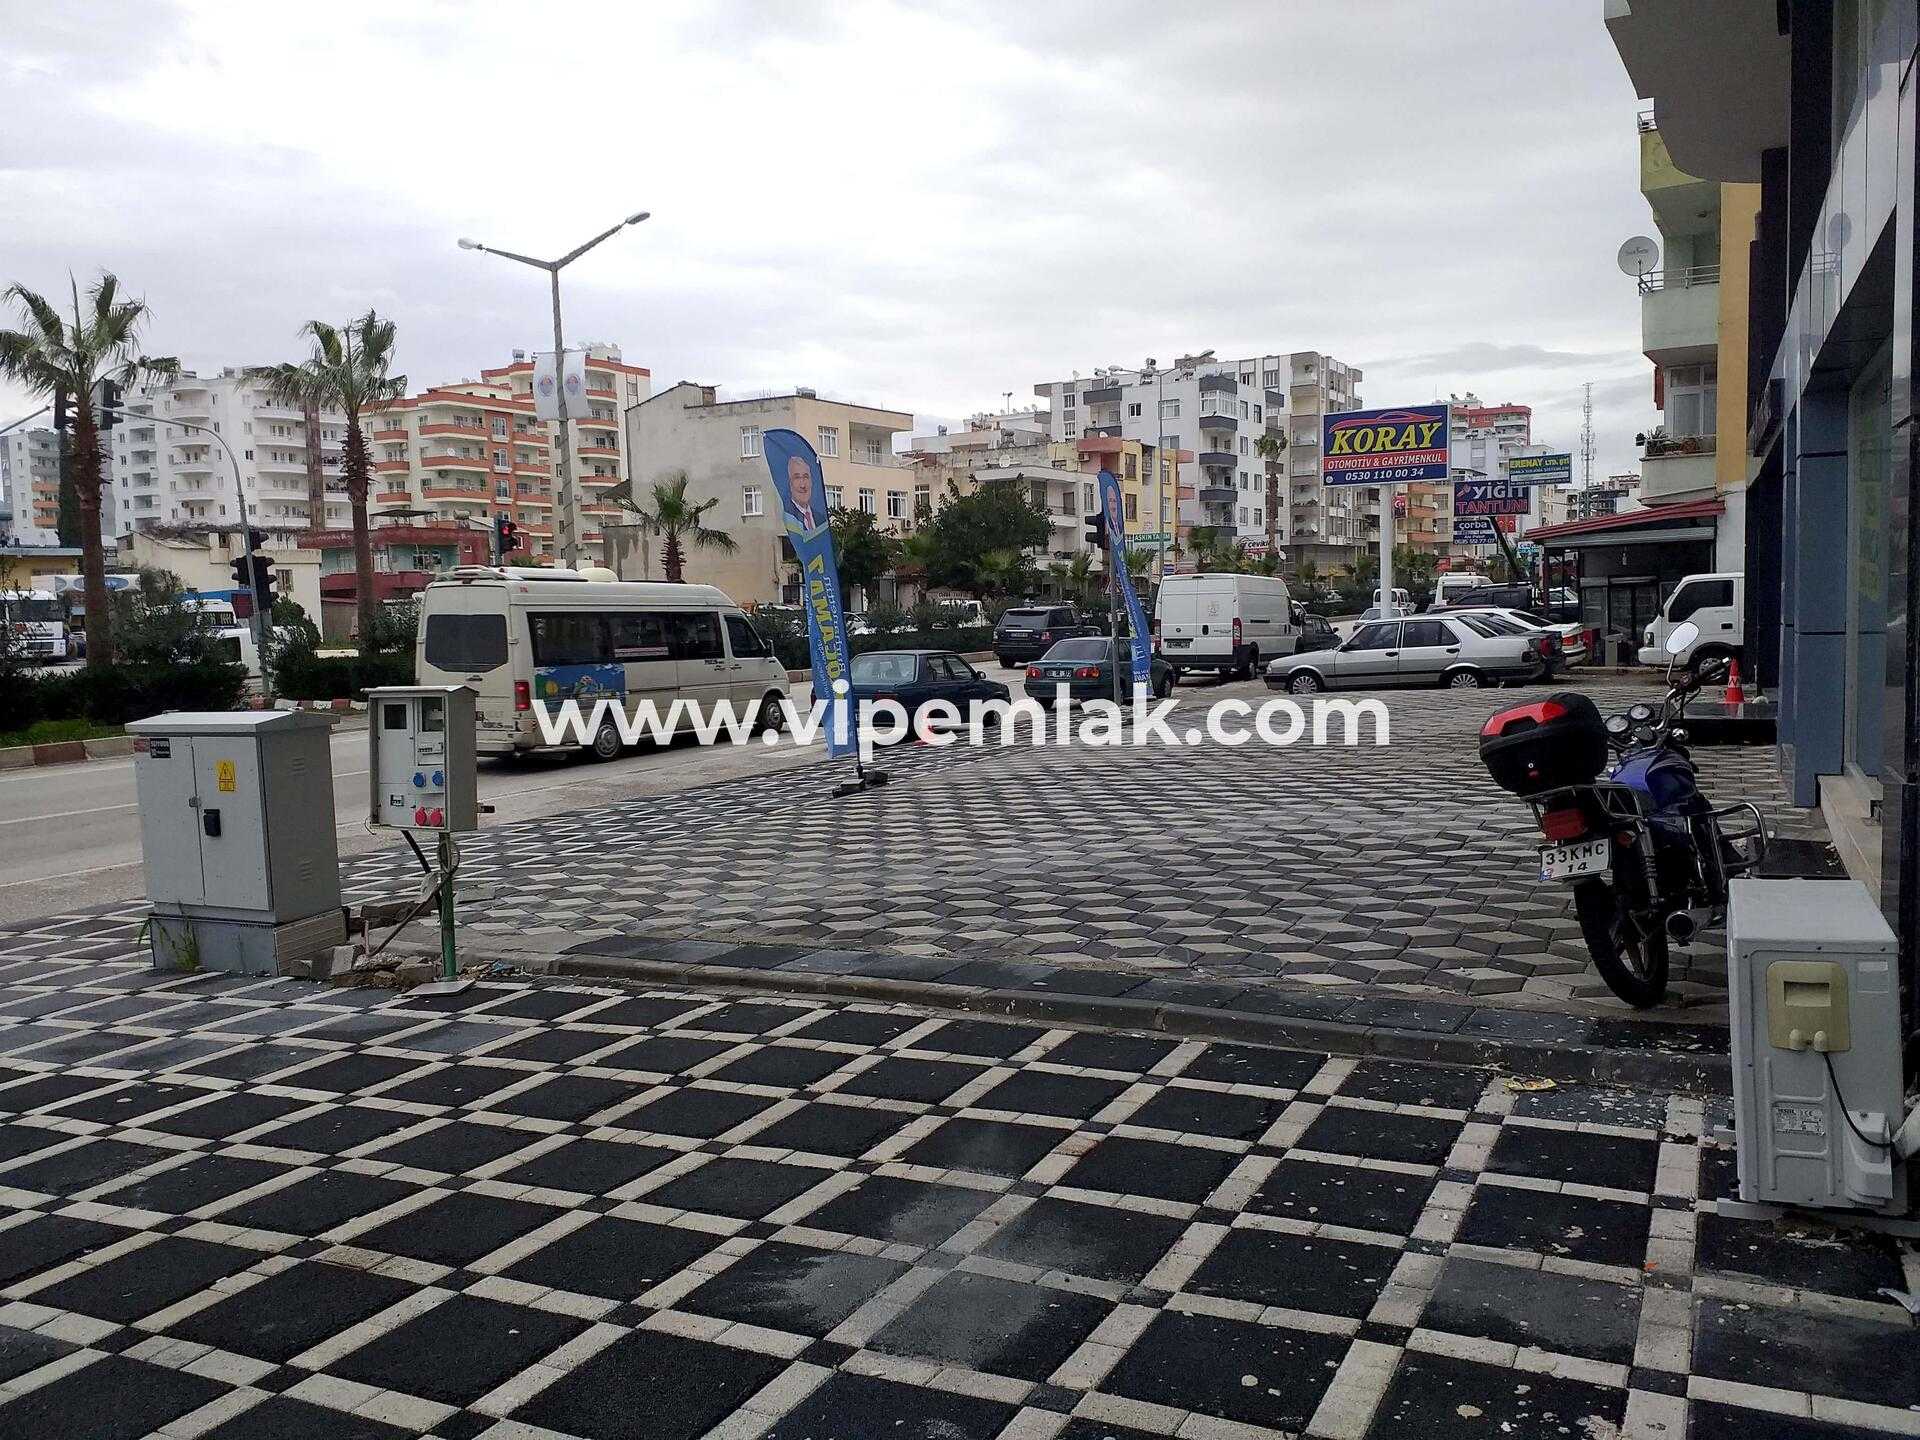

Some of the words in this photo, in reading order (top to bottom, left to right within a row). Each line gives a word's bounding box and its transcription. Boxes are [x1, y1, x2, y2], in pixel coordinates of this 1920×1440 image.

[1329, 422, 1443, 455] KORAY
[1328, 457, 1372, 470] OTOMOTİV
[1373, 457, 1380, 467] &
[1381, 453, 1442, 466] GAYRİMENKUL
[1345, 471, 1371, 481] 0530
[1373, 470, 1393, 480] 110
[1395, 469, 1408, 478] 00
[1410, 467, 1424, 477] 34
[1459, 521, 1487, 530] çorba
[1568, 861, 1588, 873] 14
